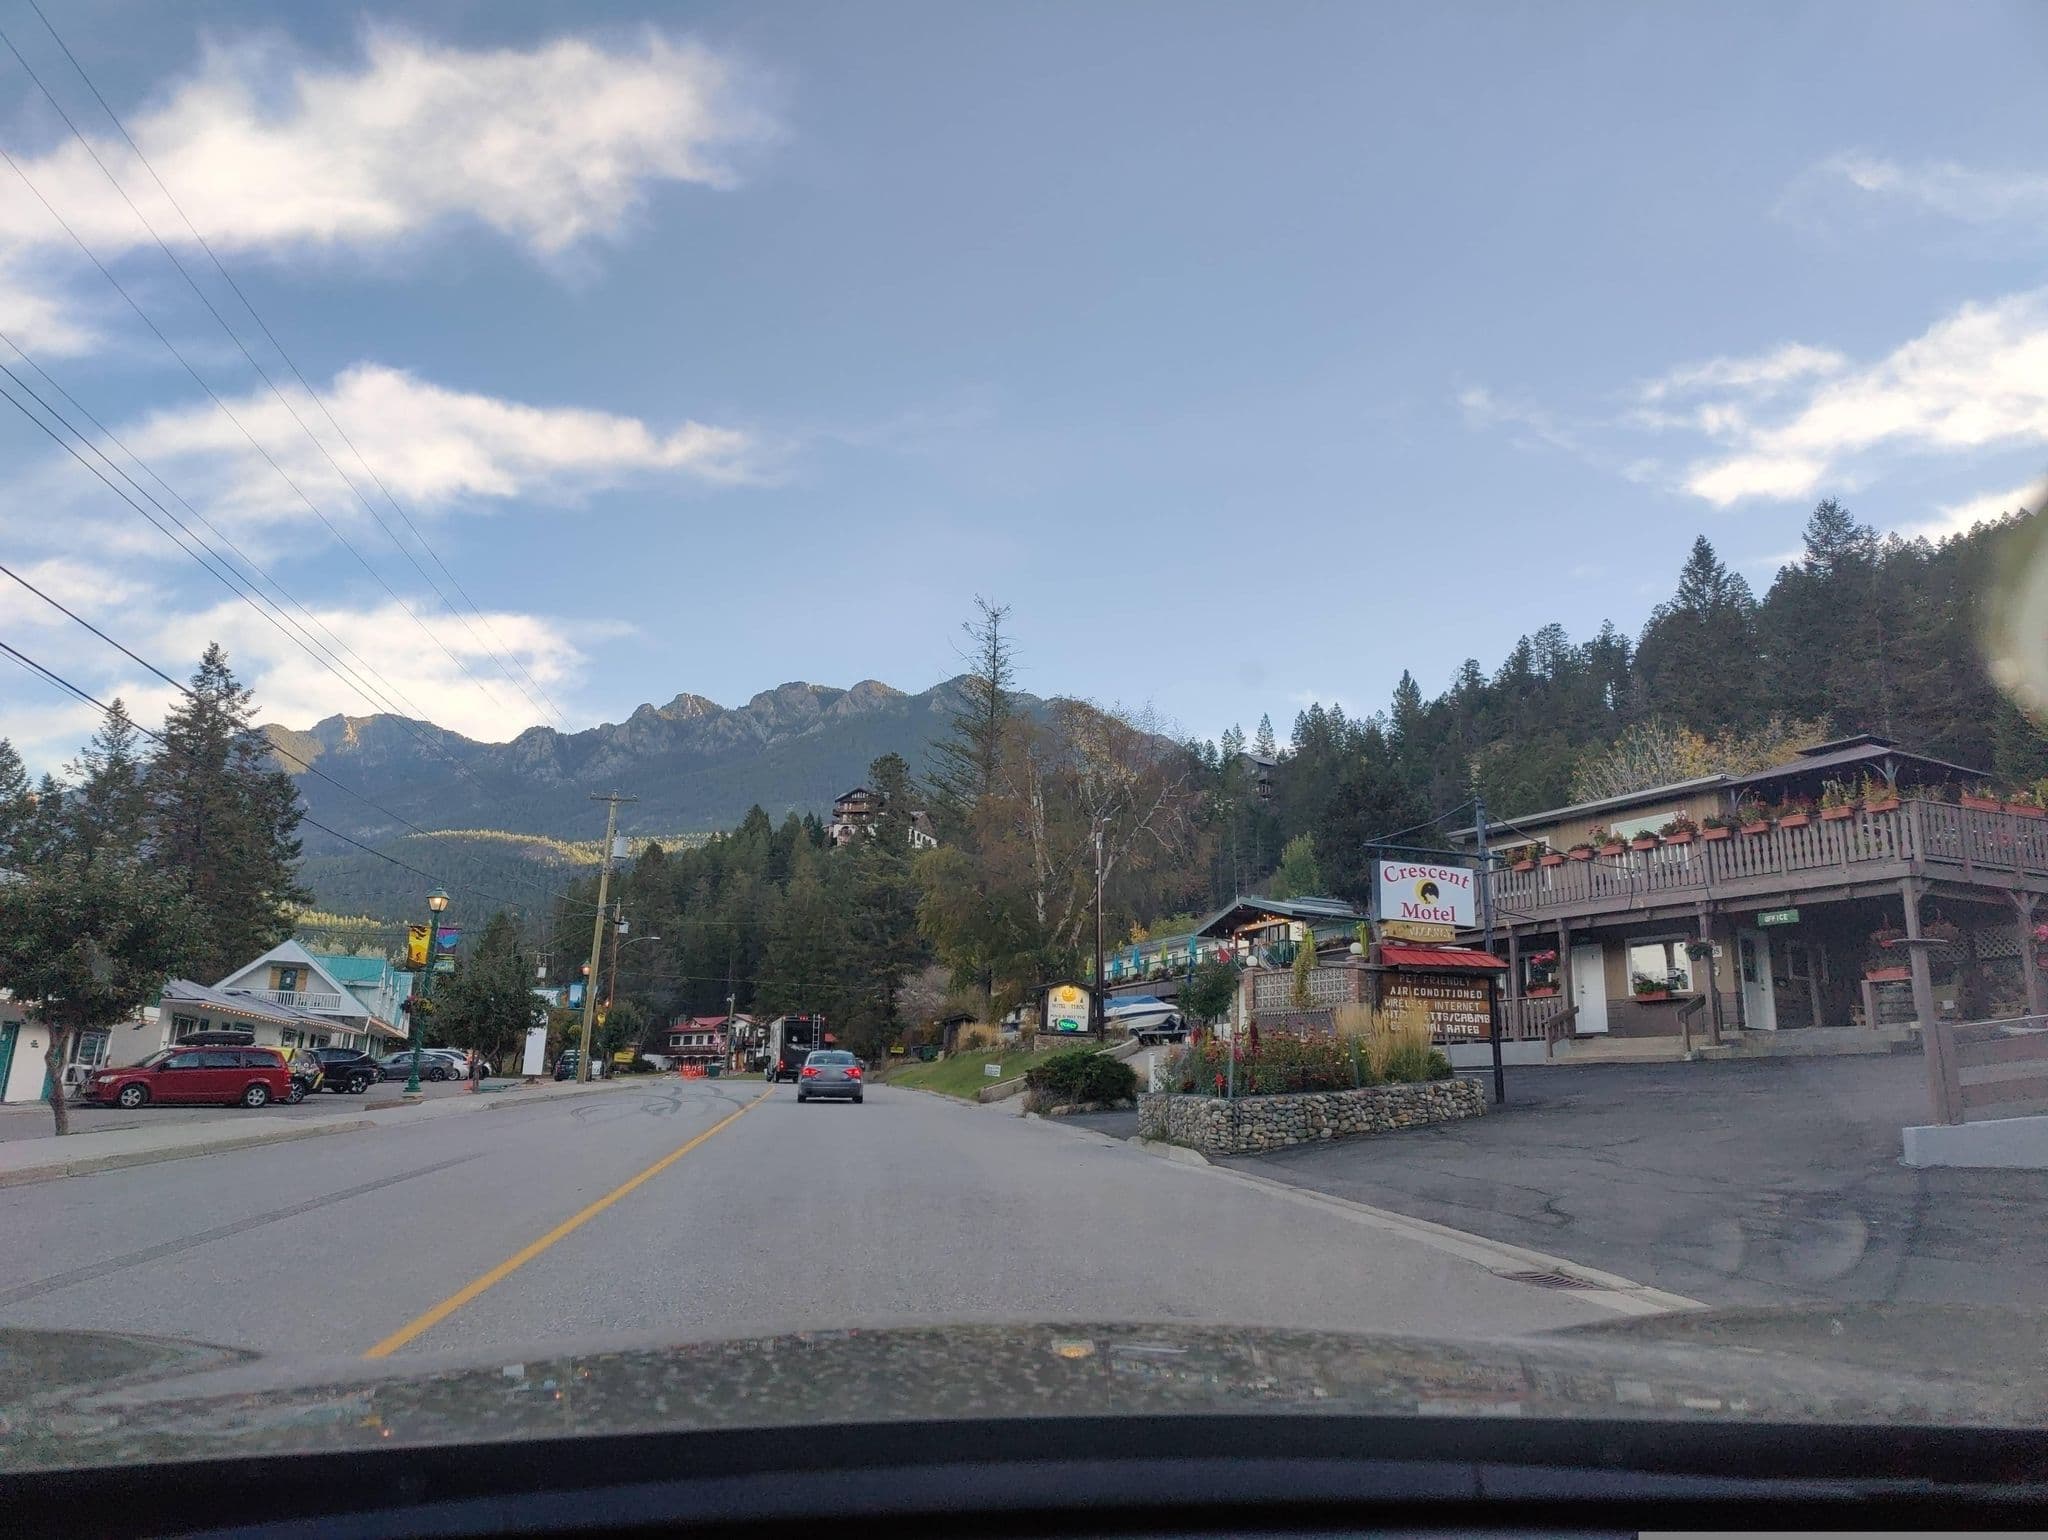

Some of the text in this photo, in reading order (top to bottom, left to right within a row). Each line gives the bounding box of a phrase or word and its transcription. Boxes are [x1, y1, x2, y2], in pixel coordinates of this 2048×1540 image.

[1383, 865, 1470, 889] Crescent
[1400, 902, 1457, 922] Motel
[1764, 913, 1788, 923] OFFICE
[1400, 974, 1471, 987] PET FRIENDLY
[1390, 986, 1483, 999] AIR CONDITIONED
[1434, 1000, 1480, 1012] INTERNET
[1446, 1024, 1480, 1035] RATES
